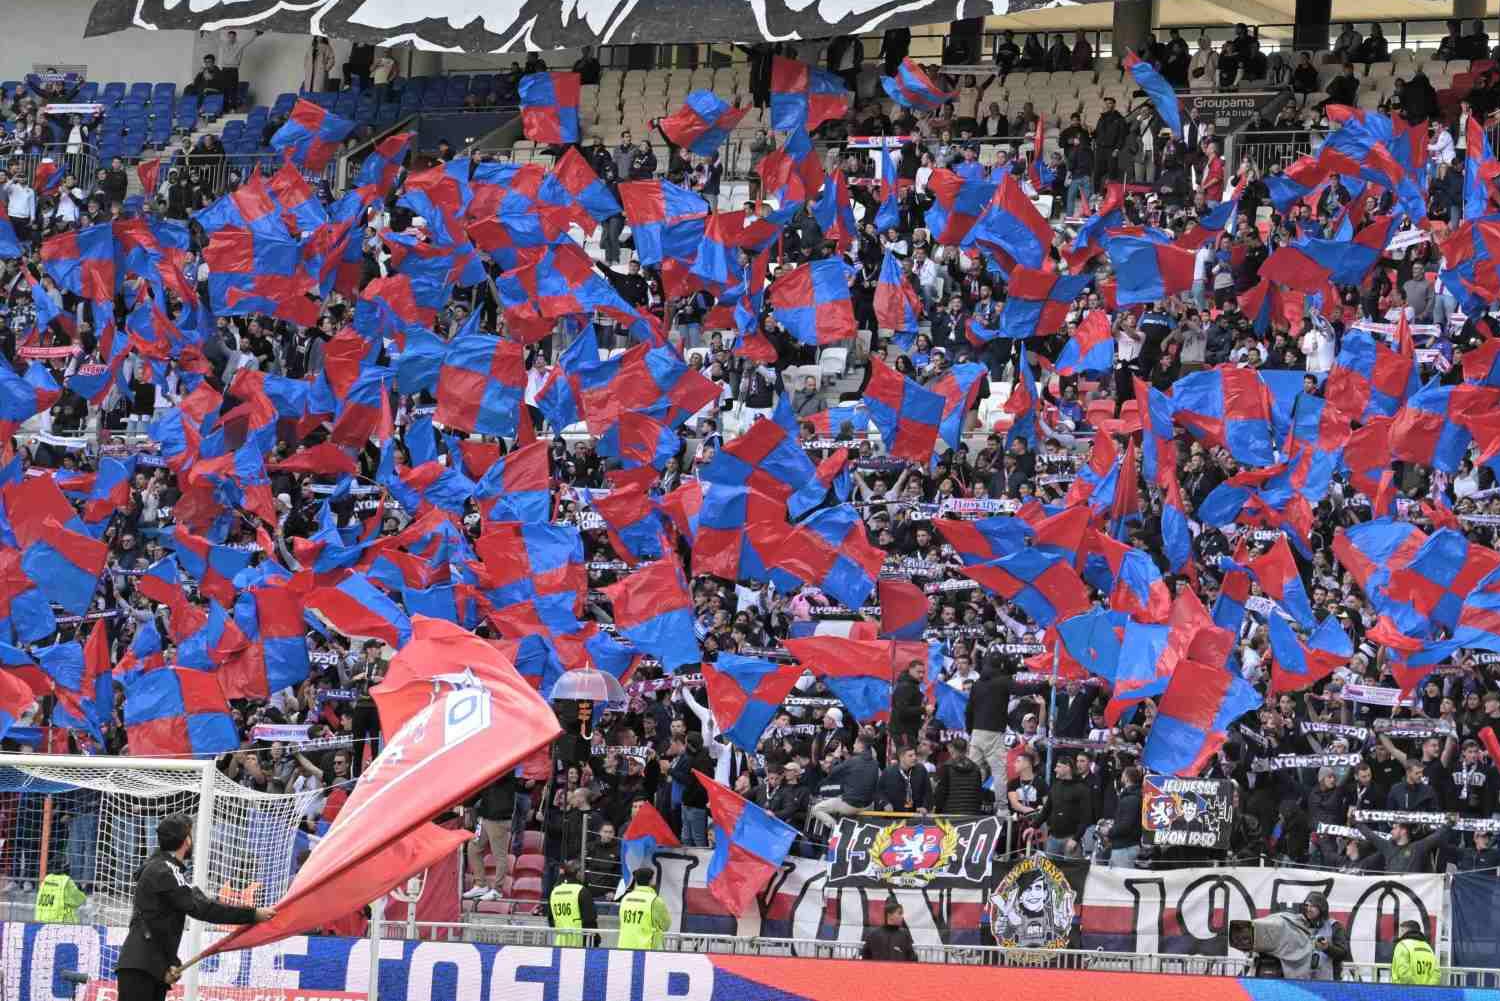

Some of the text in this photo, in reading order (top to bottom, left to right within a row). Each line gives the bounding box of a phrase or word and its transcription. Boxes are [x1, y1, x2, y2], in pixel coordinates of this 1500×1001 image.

[1193, 97, 1255, 109] Groupama
[802, 440, 832, 450] LYON
[1301, 721, 1368, 740] LYON 1950
[1271, 754, 1361, 770] LYON 1950
[1162, 780, 1220, 794] JEUNESSE
[1354, 809, 1447, 824] LYON MCML
[1154, 830, 1217, 847] LYON 1950
[623, 909, 645, 924] 0317
[345, 936, 714, 1001] COEUR
